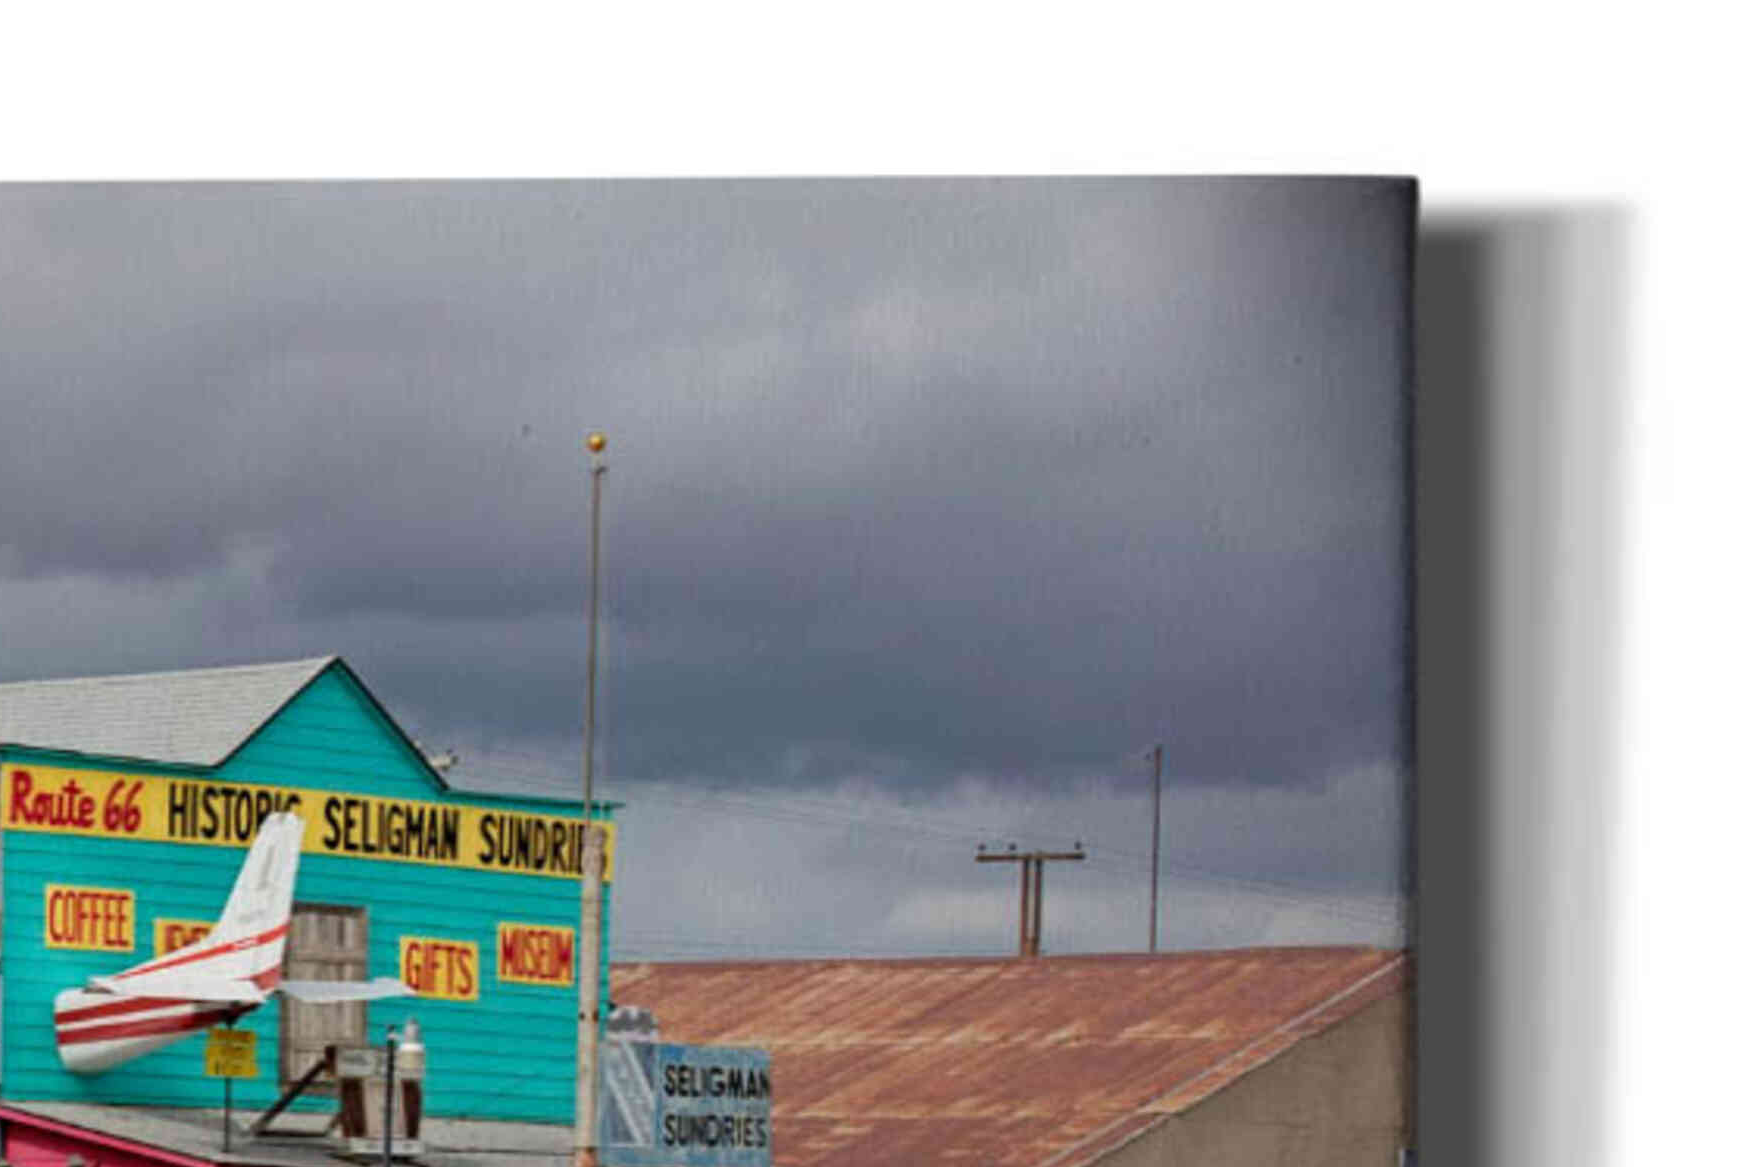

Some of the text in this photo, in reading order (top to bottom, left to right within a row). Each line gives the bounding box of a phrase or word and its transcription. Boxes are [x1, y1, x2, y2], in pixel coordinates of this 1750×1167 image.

[9, 769, 95, 830] Route
[103, 780, 144, 834] 66
[323, 797, 460, 862] SELIGMAN
[49, 889, 131, 947] COFFEE
[406, 942, 475, 998] GIFTS
[501, 928, 574, 981] MUSEUM
[664, 1064, 770, 1099] SELIGMAN
[664, 1114, 768, 1148] SUNDRIES
